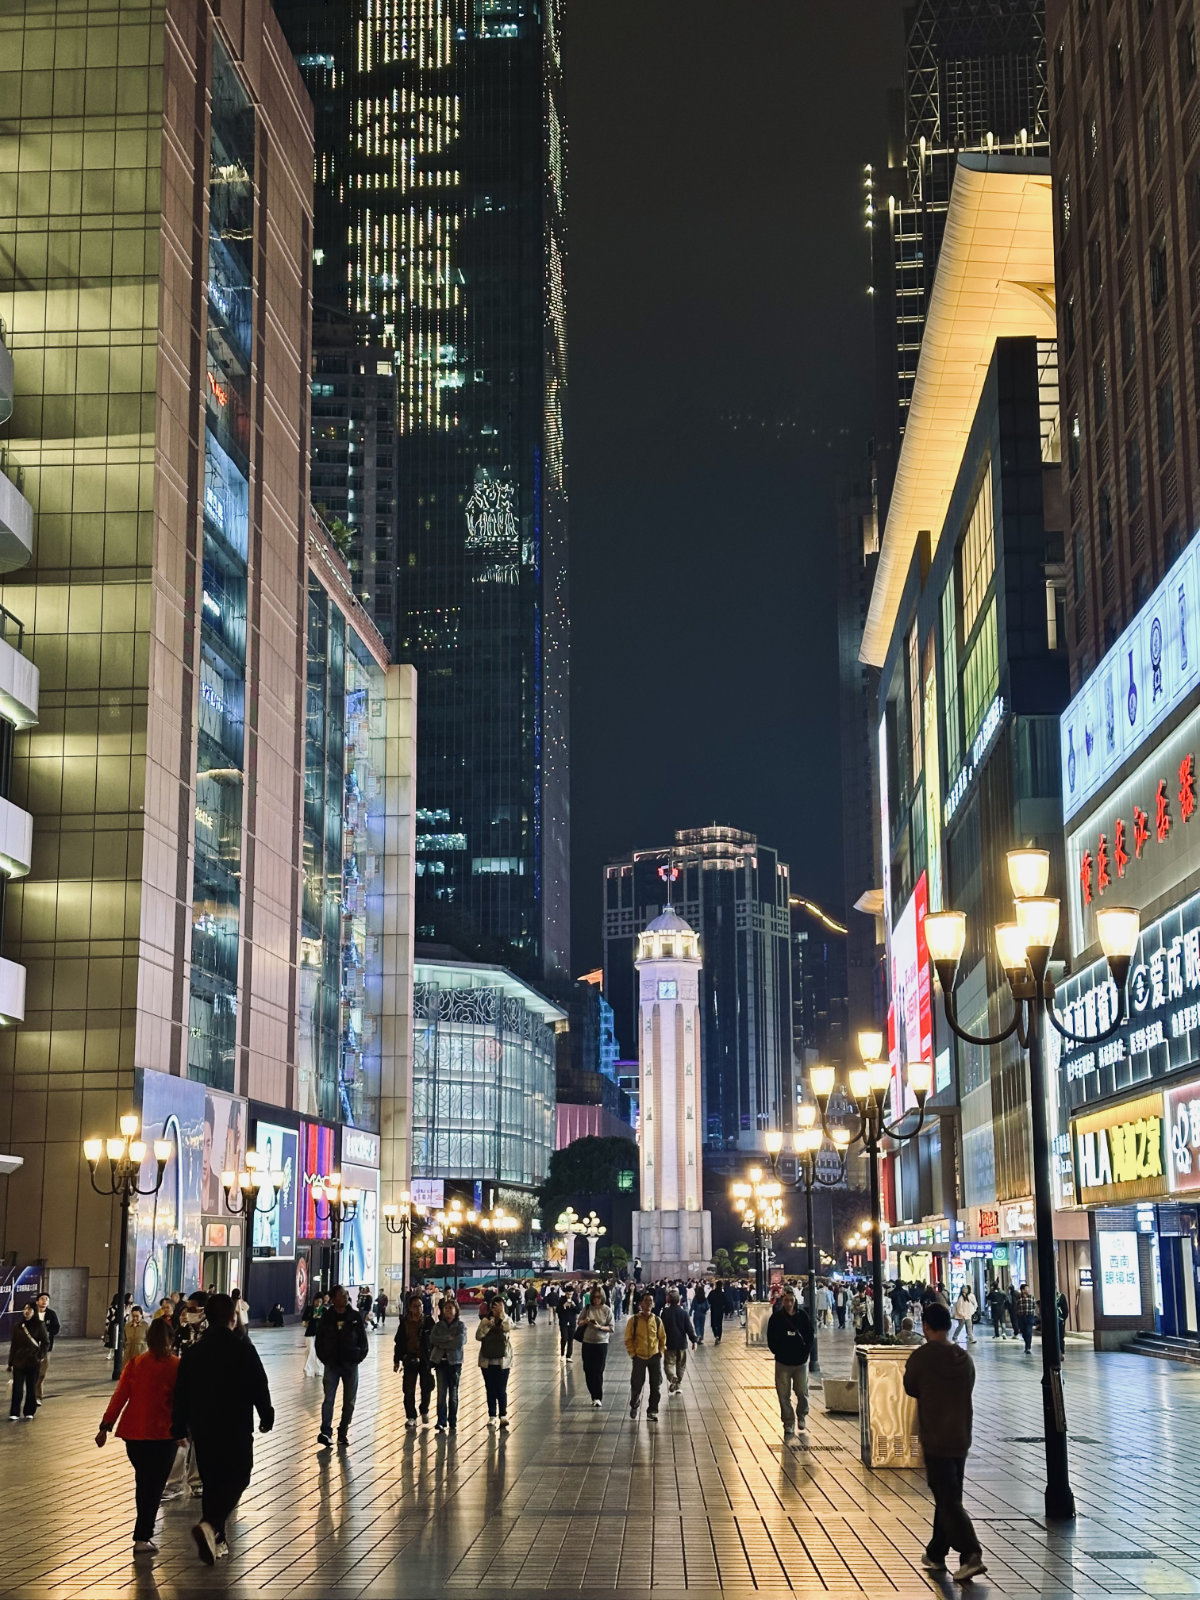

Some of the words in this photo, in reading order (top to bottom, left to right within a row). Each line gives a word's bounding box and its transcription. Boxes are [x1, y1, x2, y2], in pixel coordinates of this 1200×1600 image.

[1078, 1128, 1113, 1188] HLA
[1111, 1115, 1163, 1183] 海澜之家
[1109, 1255, 1129, 1268] 西南
[1105, 1271, 1136, 1285] 眼镜城
